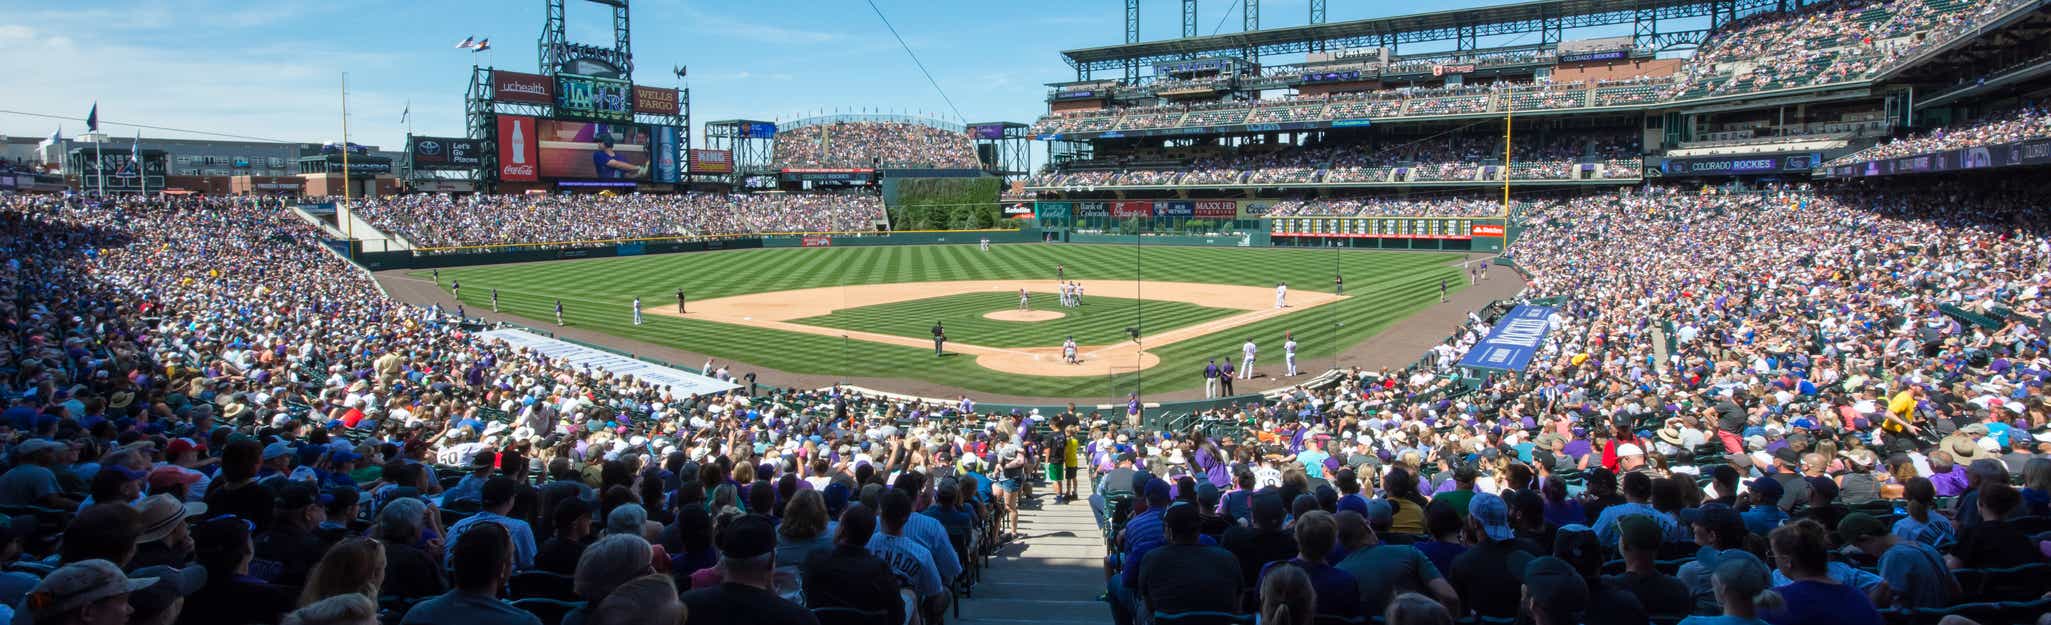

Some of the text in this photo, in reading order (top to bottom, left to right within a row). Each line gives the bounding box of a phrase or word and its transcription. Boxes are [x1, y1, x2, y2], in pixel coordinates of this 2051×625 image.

[503, 80, 545, 93] uchealth
[637, 89, 673, 101] WELLS
[639, 99, 673, 110] FARGO
[1692, 159, 1771, 171] COLORADO ROCKIES
[1080, 202, 1103, 210] Bank of
[1196, 201, 1235, 210] MAXX HD
[440, 452, 458, 465] 50
